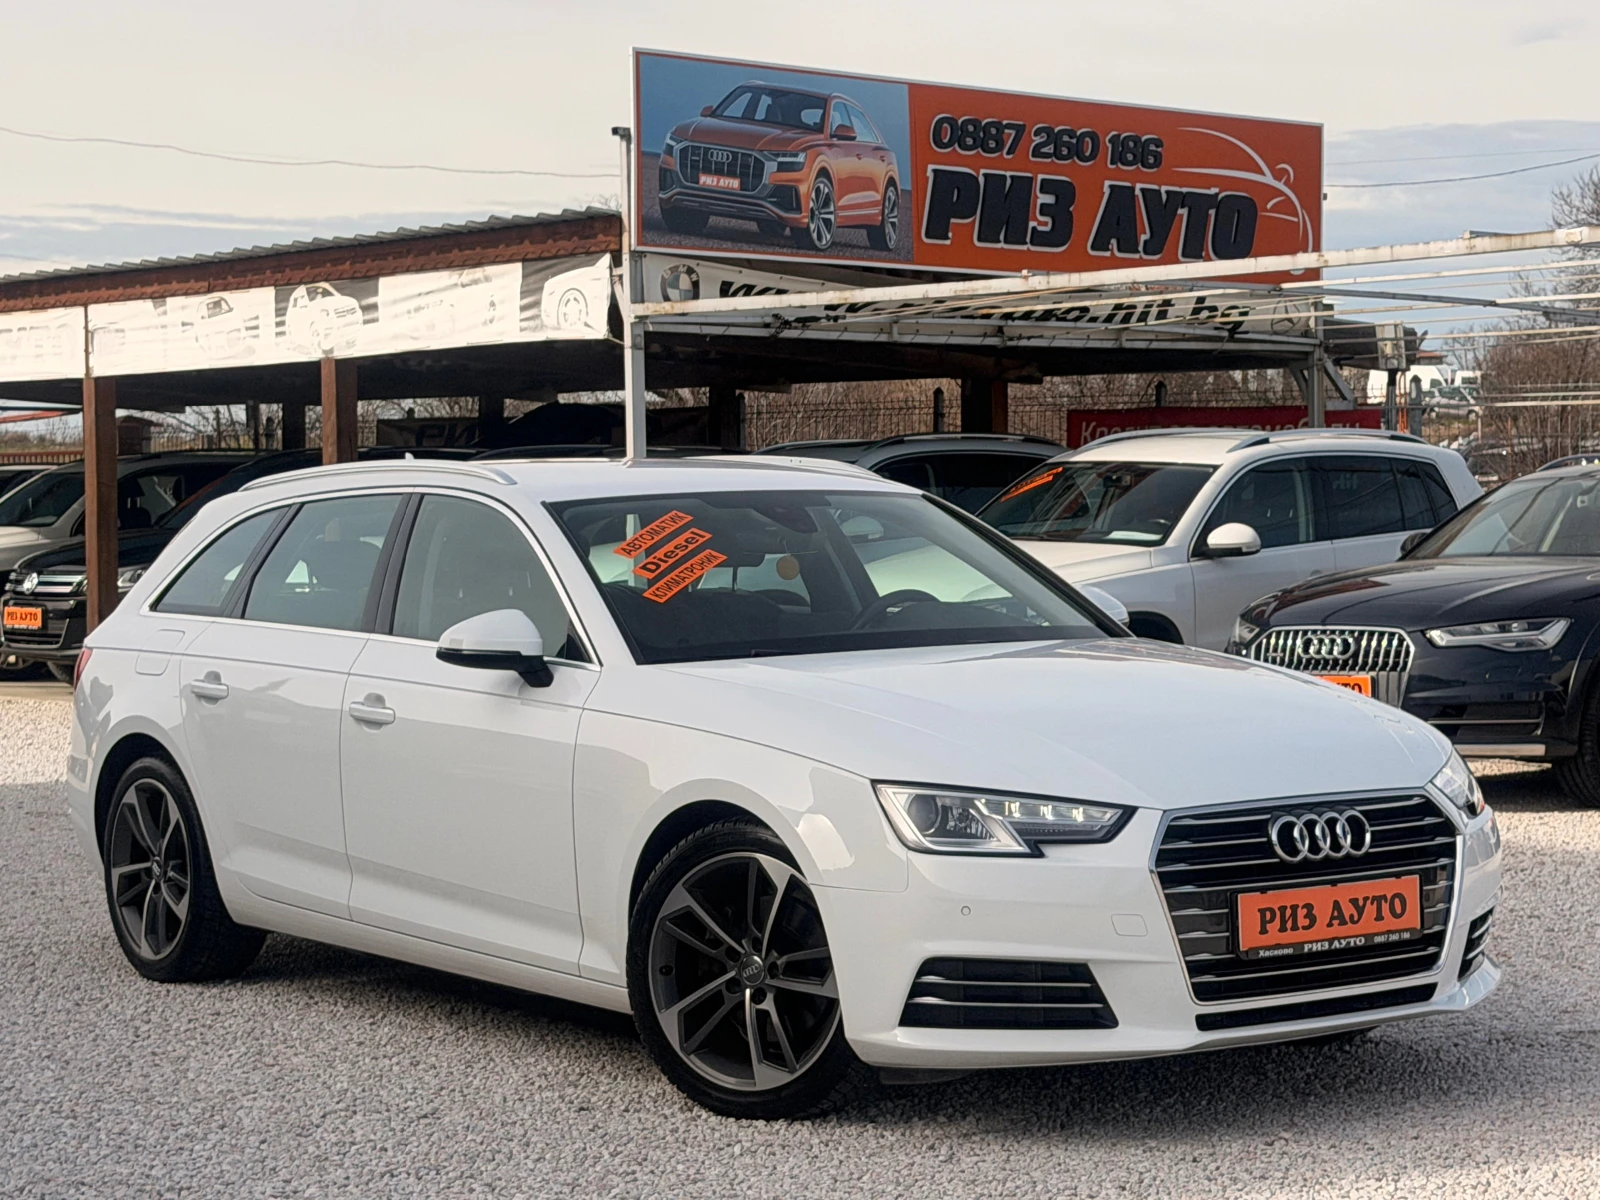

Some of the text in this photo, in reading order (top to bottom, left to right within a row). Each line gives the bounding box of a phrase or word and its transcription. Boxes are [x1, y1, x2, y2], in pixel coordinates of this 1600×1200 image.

[930, 113, 1164, 171] 0887 260 186
[922, 164, 1258, 261] РИЗ АУТО
[620, 512, 688, 556] АВТОМАТИК
[639, 530, 707, 574] Diesel
[651, 552, 721, 600] КЛИМАТРОНИК
[1258, 893, 1407, 935] РИЗ АУТО
[1303, 942, 1329, 952] РИЗ
[1330, 936, 1365, 949] АУТО
